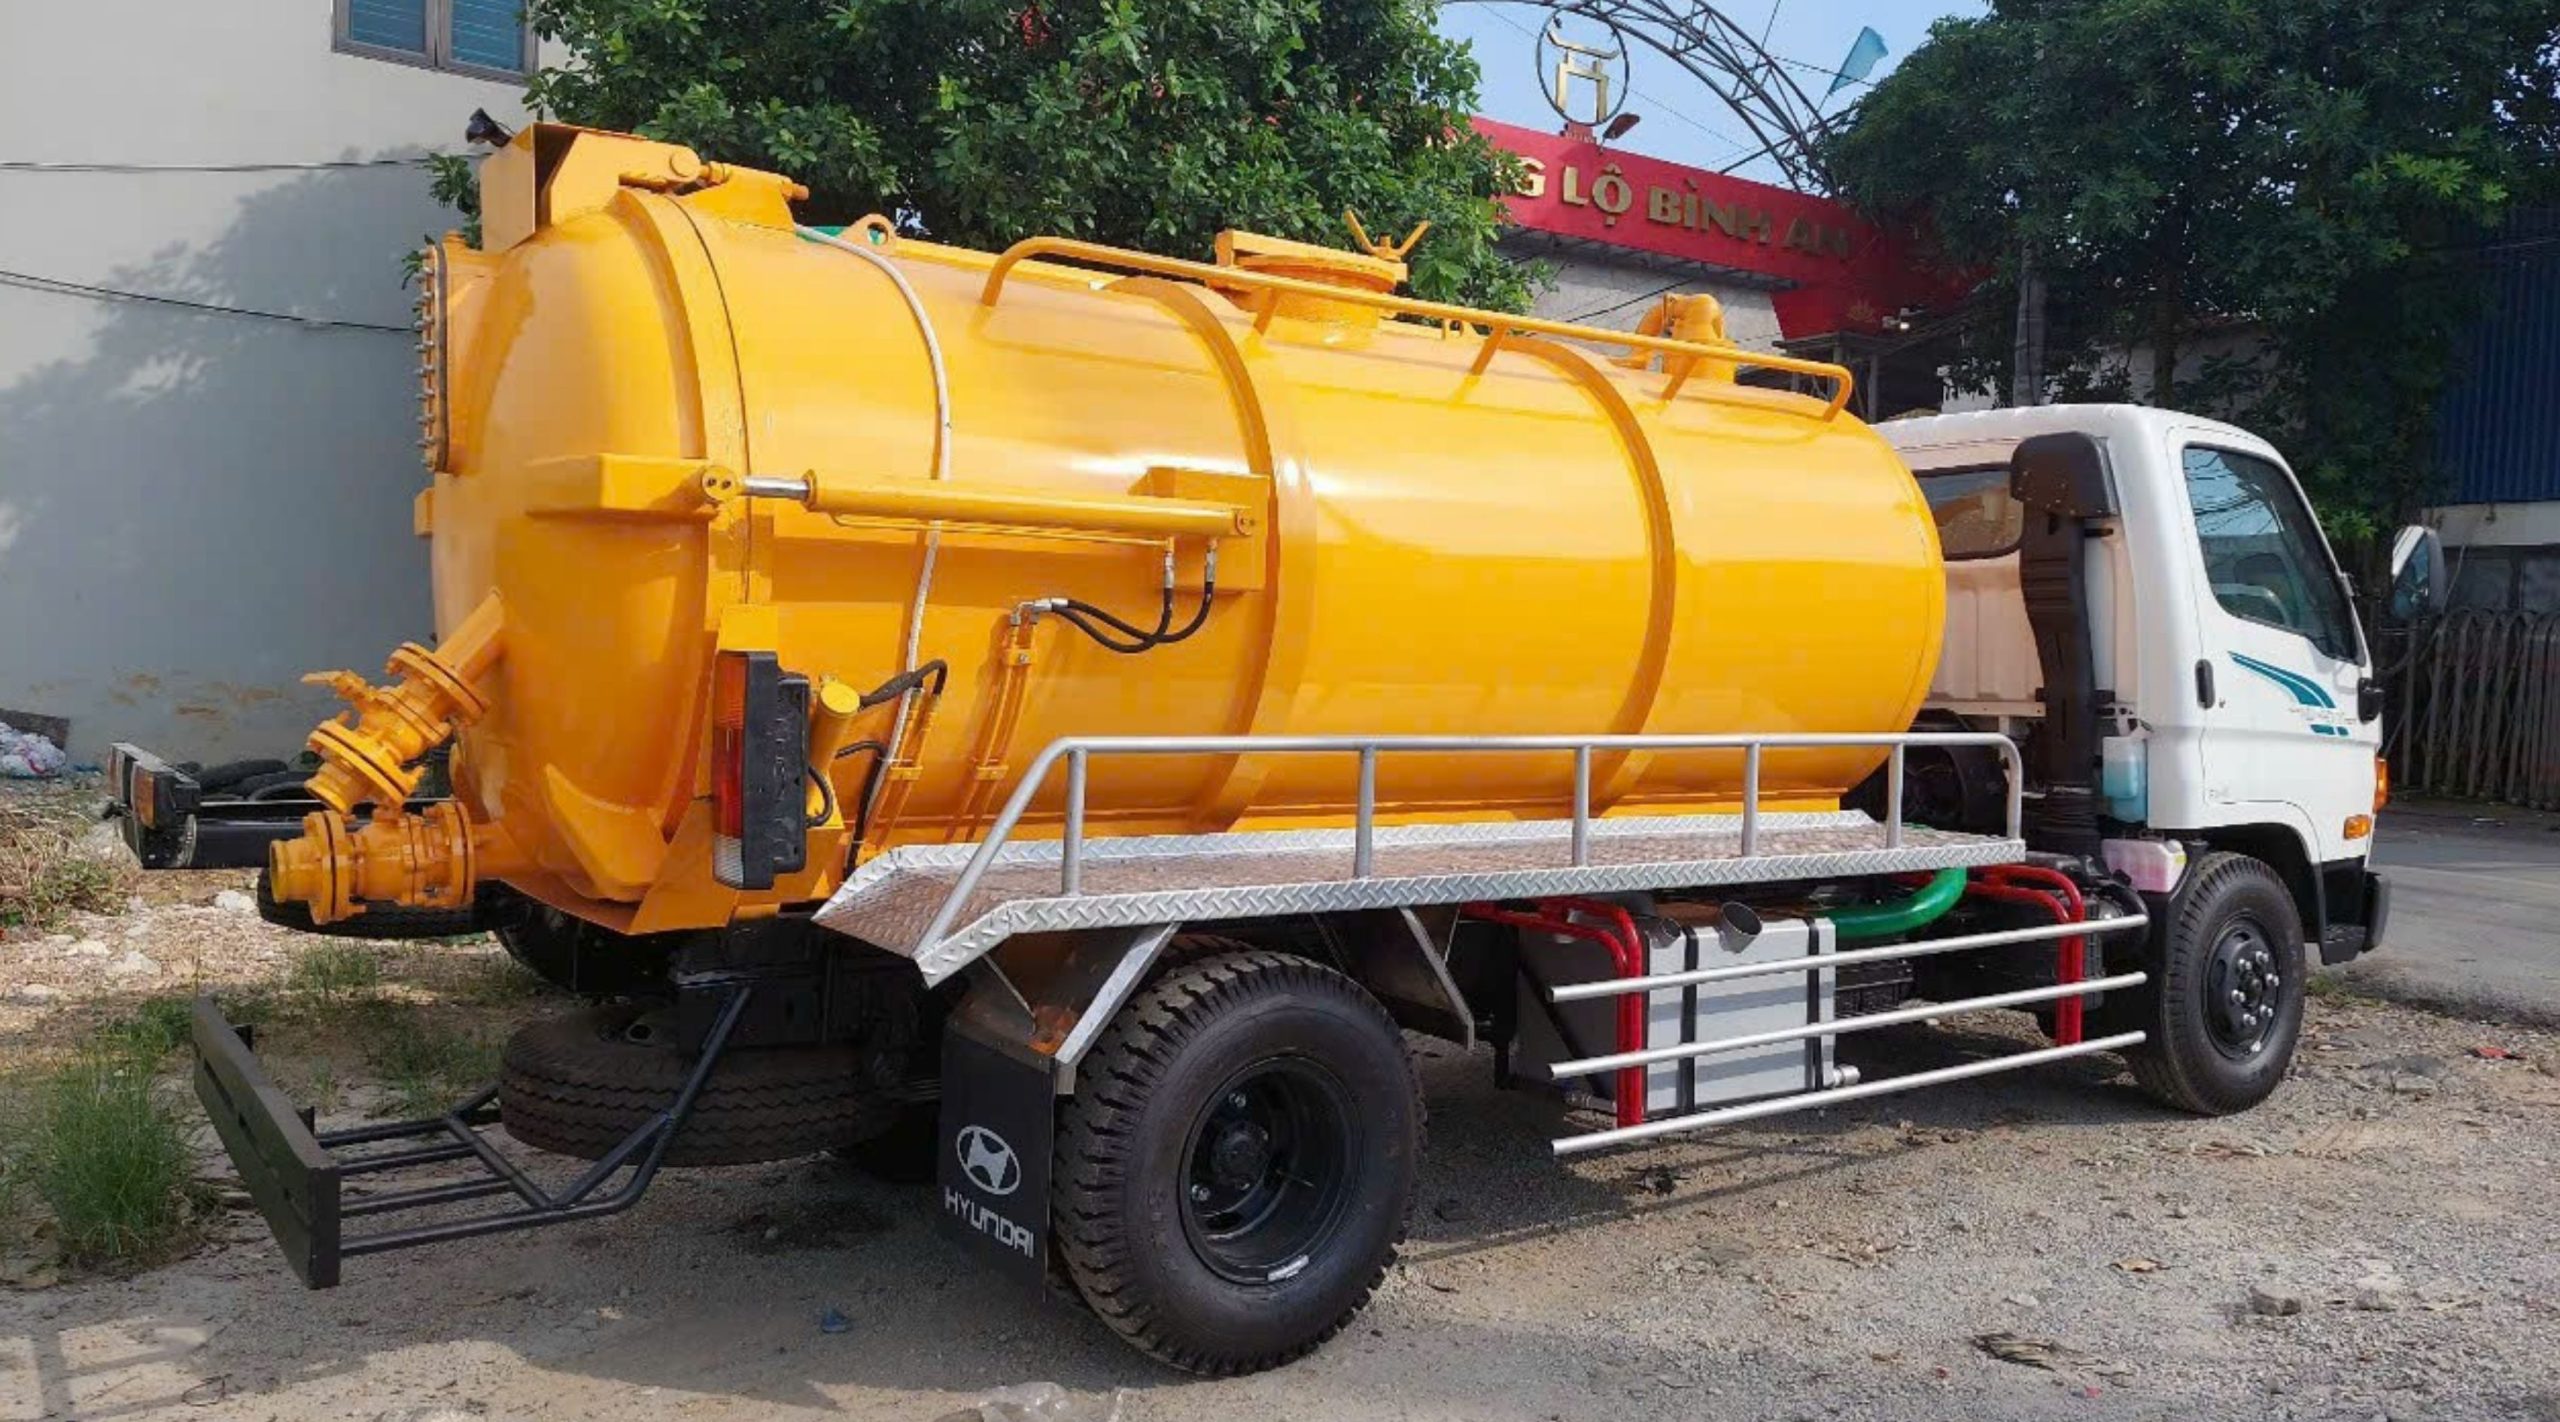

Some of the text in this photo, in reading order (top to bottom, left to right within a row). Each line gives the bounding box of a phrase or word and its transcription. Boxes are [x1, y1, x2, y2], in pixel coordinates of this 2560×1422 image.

[1562, 163, 1632, 226] LỘ
[1648, 178, 1771, 245] BÌNH
[945, 1186, 1034, 1258] HYUNDAI
